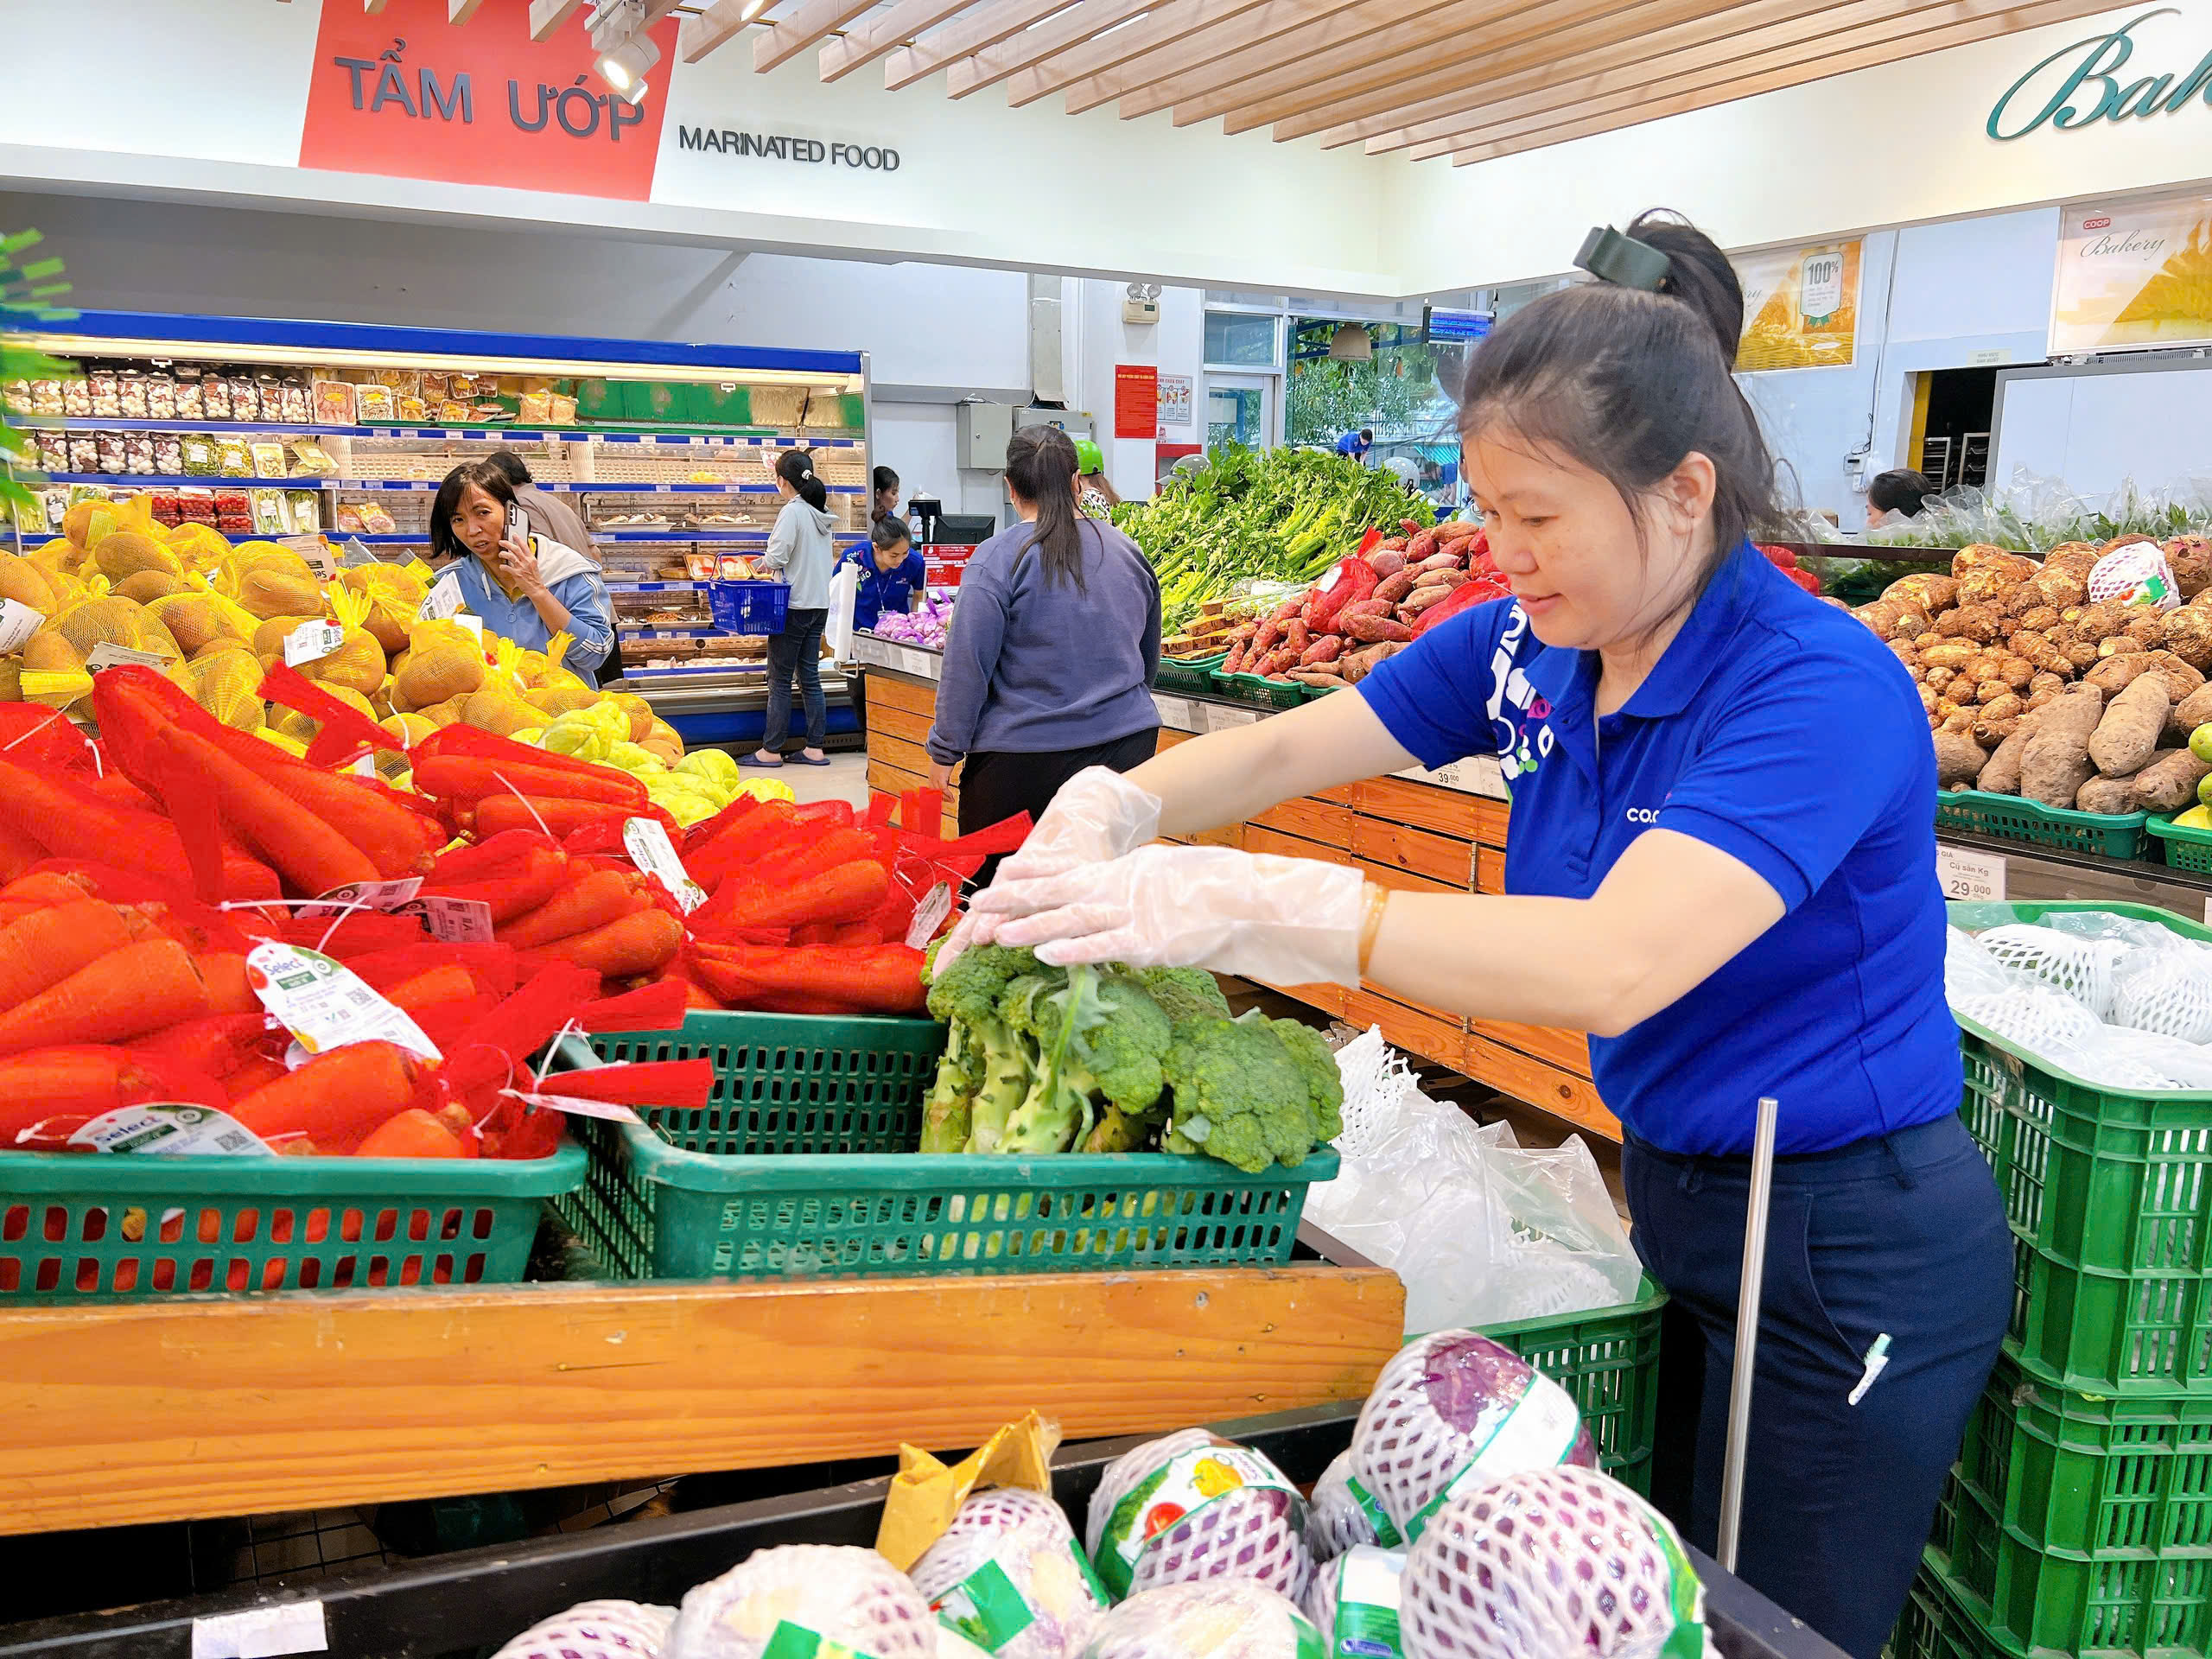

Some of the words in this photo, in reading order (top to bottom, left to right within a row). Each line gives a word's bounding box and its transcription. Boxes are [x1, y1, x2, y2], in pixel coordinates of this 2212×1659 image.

[334, 37, 474, 124] TẨM
[507, 74, 645, 143] ƯỚP
[678, 124, 826, 164] MARINATED
[831, 142, 901, 173] FOOD
[2083, 219, 2110, 229] COOP
[2080, 229, 2168, 262] Bakery
[1808, 261, 1839, 286] 100%
[1978, 867, 1989, 877] Kg
[263, 957, 305, 976] Select
[94, 1113, 163, 1144] Select
